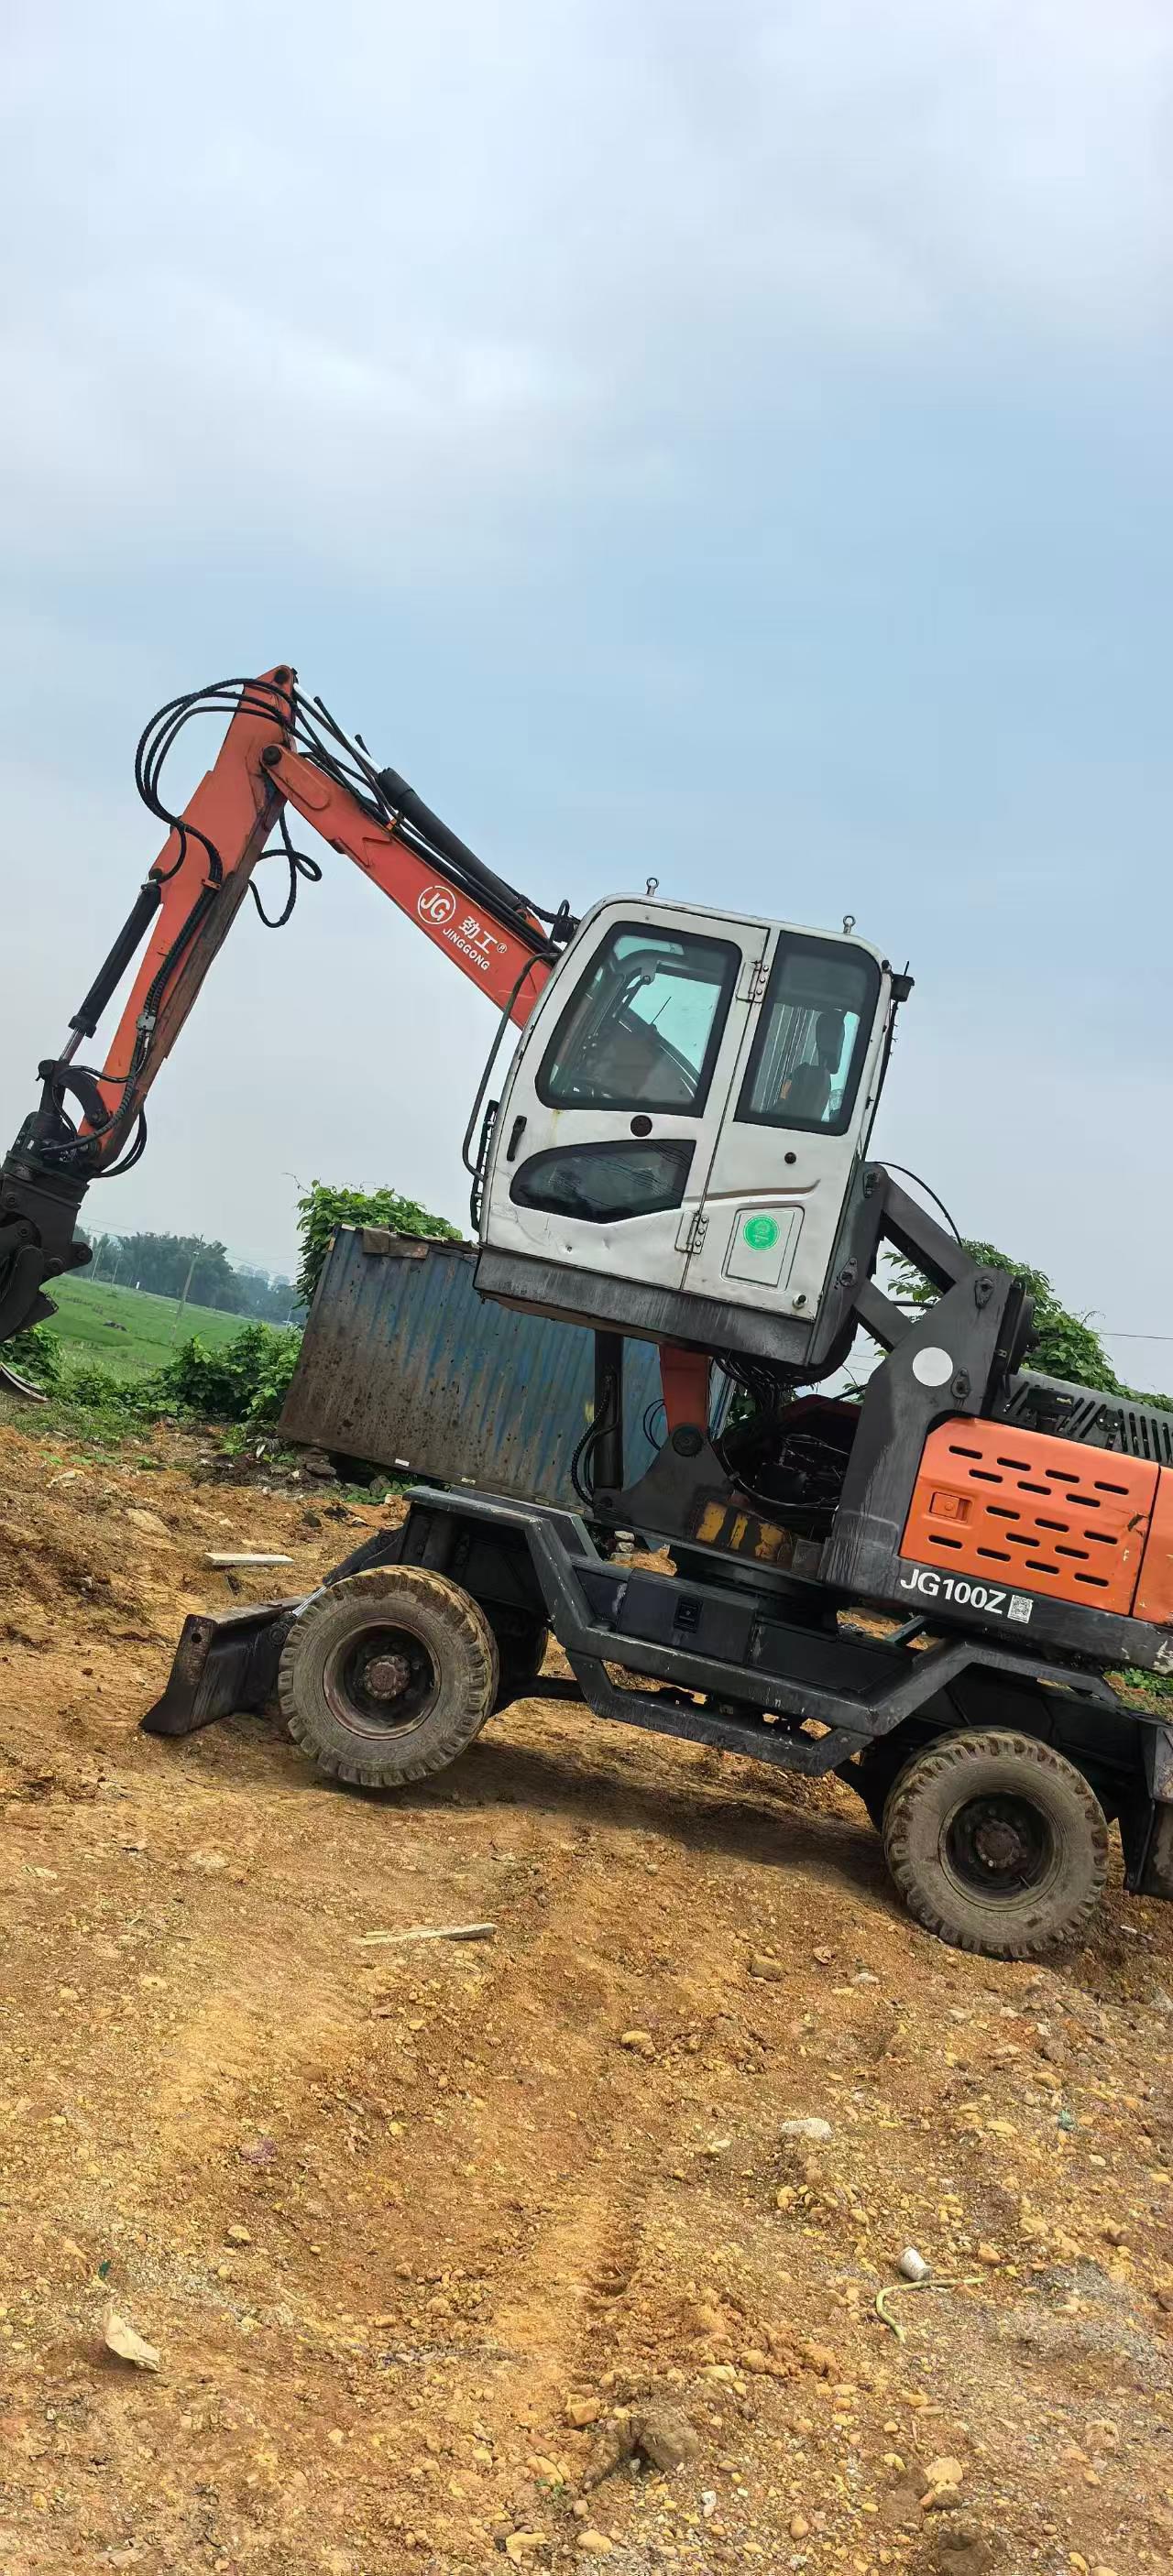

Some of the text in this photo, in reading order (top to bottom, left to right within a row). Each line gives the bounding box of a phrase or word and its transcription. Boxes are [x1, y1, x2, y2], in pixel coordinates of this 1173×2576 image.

[421, 892, 450, 921] JG
[443, 928, 489, 970] JINGGONG
[900, 1568, 1007, 1614] JG100Z
